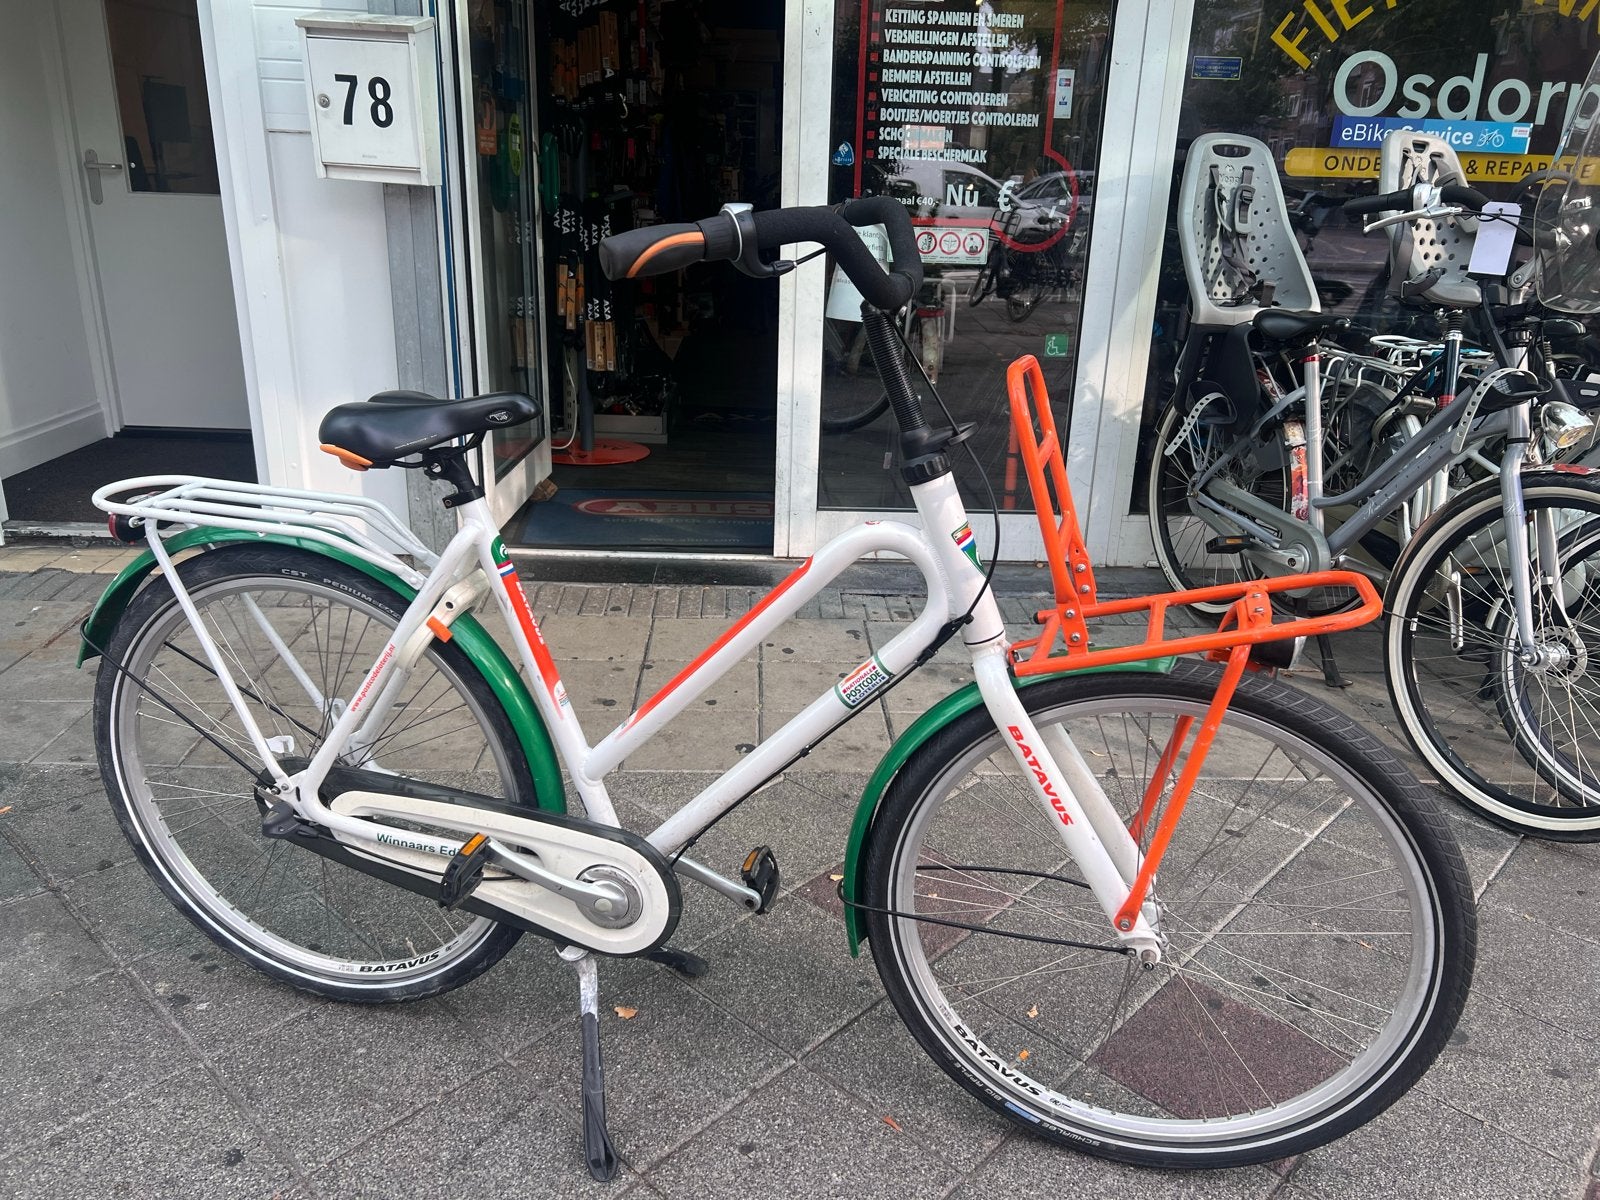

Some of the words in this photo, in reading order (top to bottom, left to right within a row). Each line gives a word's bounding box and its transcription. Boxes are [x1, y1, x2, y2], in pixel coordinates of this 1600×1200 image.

[884, 8, 926, 25] KETTING
[926, 10, 972, 27] SPANNEN
[972, 12, 986, 27] EN
[986, 12, 1025, 29] SMEREN
[884, 28, 960, 46] VERSNELLINGEN
[960, 31, 1009, 48] AFSTELLEN
[883, 49, 971, 67] BANDENSPANNING
[972, 52, 1042, 70] CONTROLEREN
[881, 69, 923, 85] REMMEN
[923, 71, 972, 86] AFSTELLEN
[334, 74, 394, 128] 78
[881, 87, 938, 104] VERICHTING
[939, 90, 1009, 107] CONTROLEREN
[880, 107, 970, 126] BOUTJES/MOERTJES
[971, 111, 1040, 128] CONTROLEREN
[877, 145, 920, 161] SPECIALE
[920, 148, 988, 164] BESCHERMLAK
[1465, 160, 1478, 175] &
[945, 184, 980, 208] Nu
[997, 179, 1016, 213] €
[605, 501, 771, 516] ABUS
[281, 568, 308, 578] CST
[323, 577, 373, 602] PEDIUM
[845, 667, 874, 692] NATIONALE
[845, 669, 882, 701] POSTCODE
[1007, 725, 1074, 826] BATAVUS
[376, 832, 436, 853] Winnaars
[439, 845, 461, 857] Ed
[359, 950, 440, 973] BATAVUS
[952, 1024, 1043, 1097] BATAVUS
